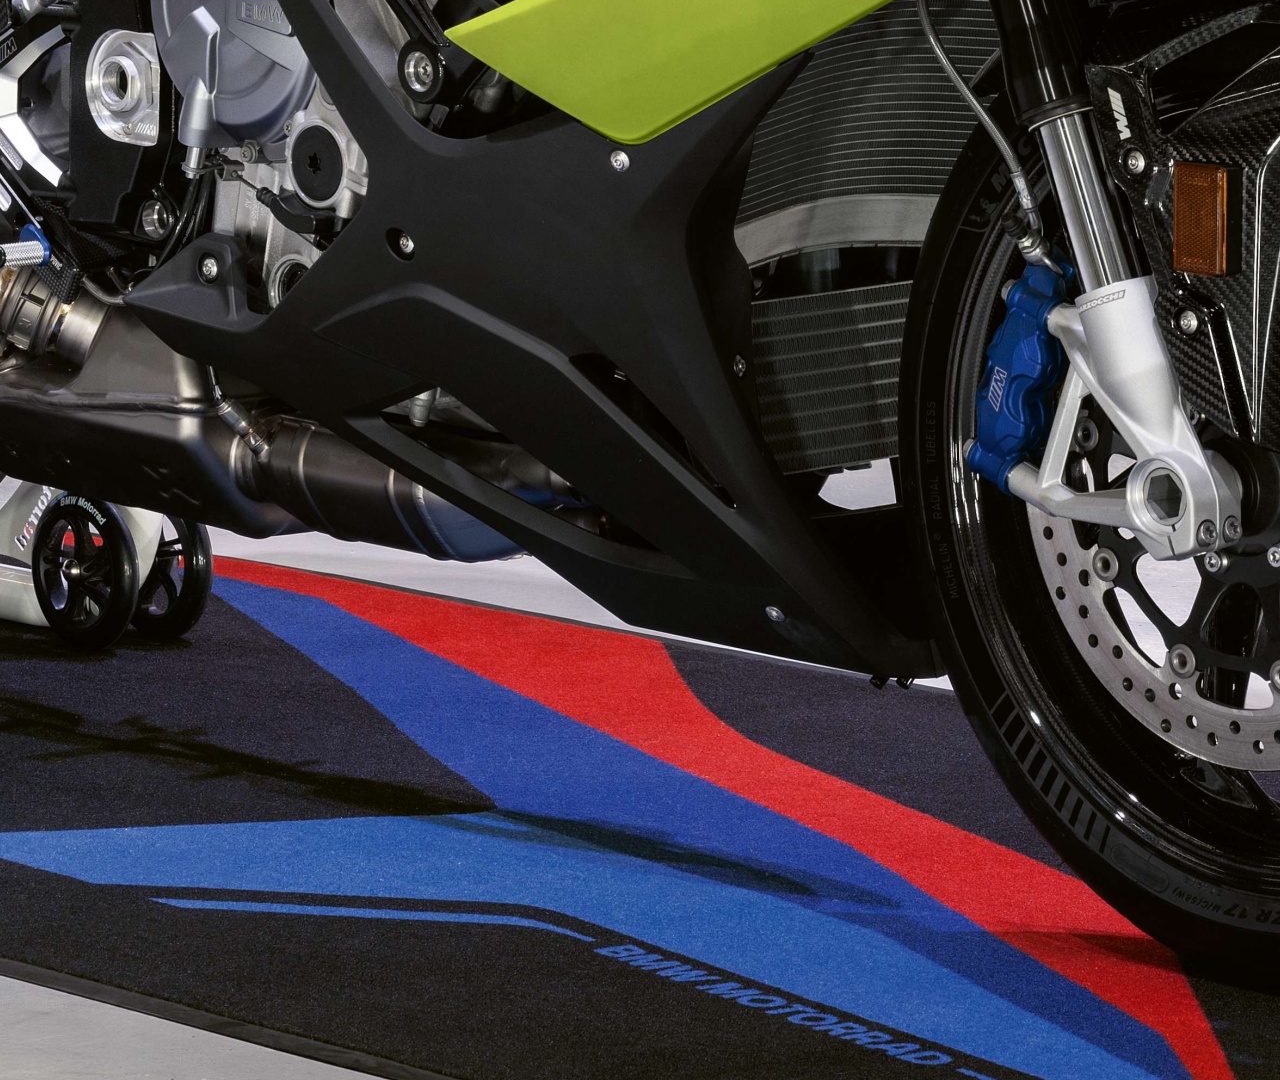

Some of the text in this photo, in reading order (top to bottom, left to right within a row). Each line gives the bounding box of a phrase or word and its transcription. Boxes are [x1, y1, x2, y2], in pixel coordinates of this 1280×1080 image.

[926, 400, 936, 464] TUBELESS
[60, 496, 107, 526] BMW Motorrad
[932, 476, 942, 520] RADIAL
[939, 542, 959, 599] MICHELIN
[1223, 903, 1249, 920] 17
[593, 944, 951, 1066] BMW MOTORRAD
